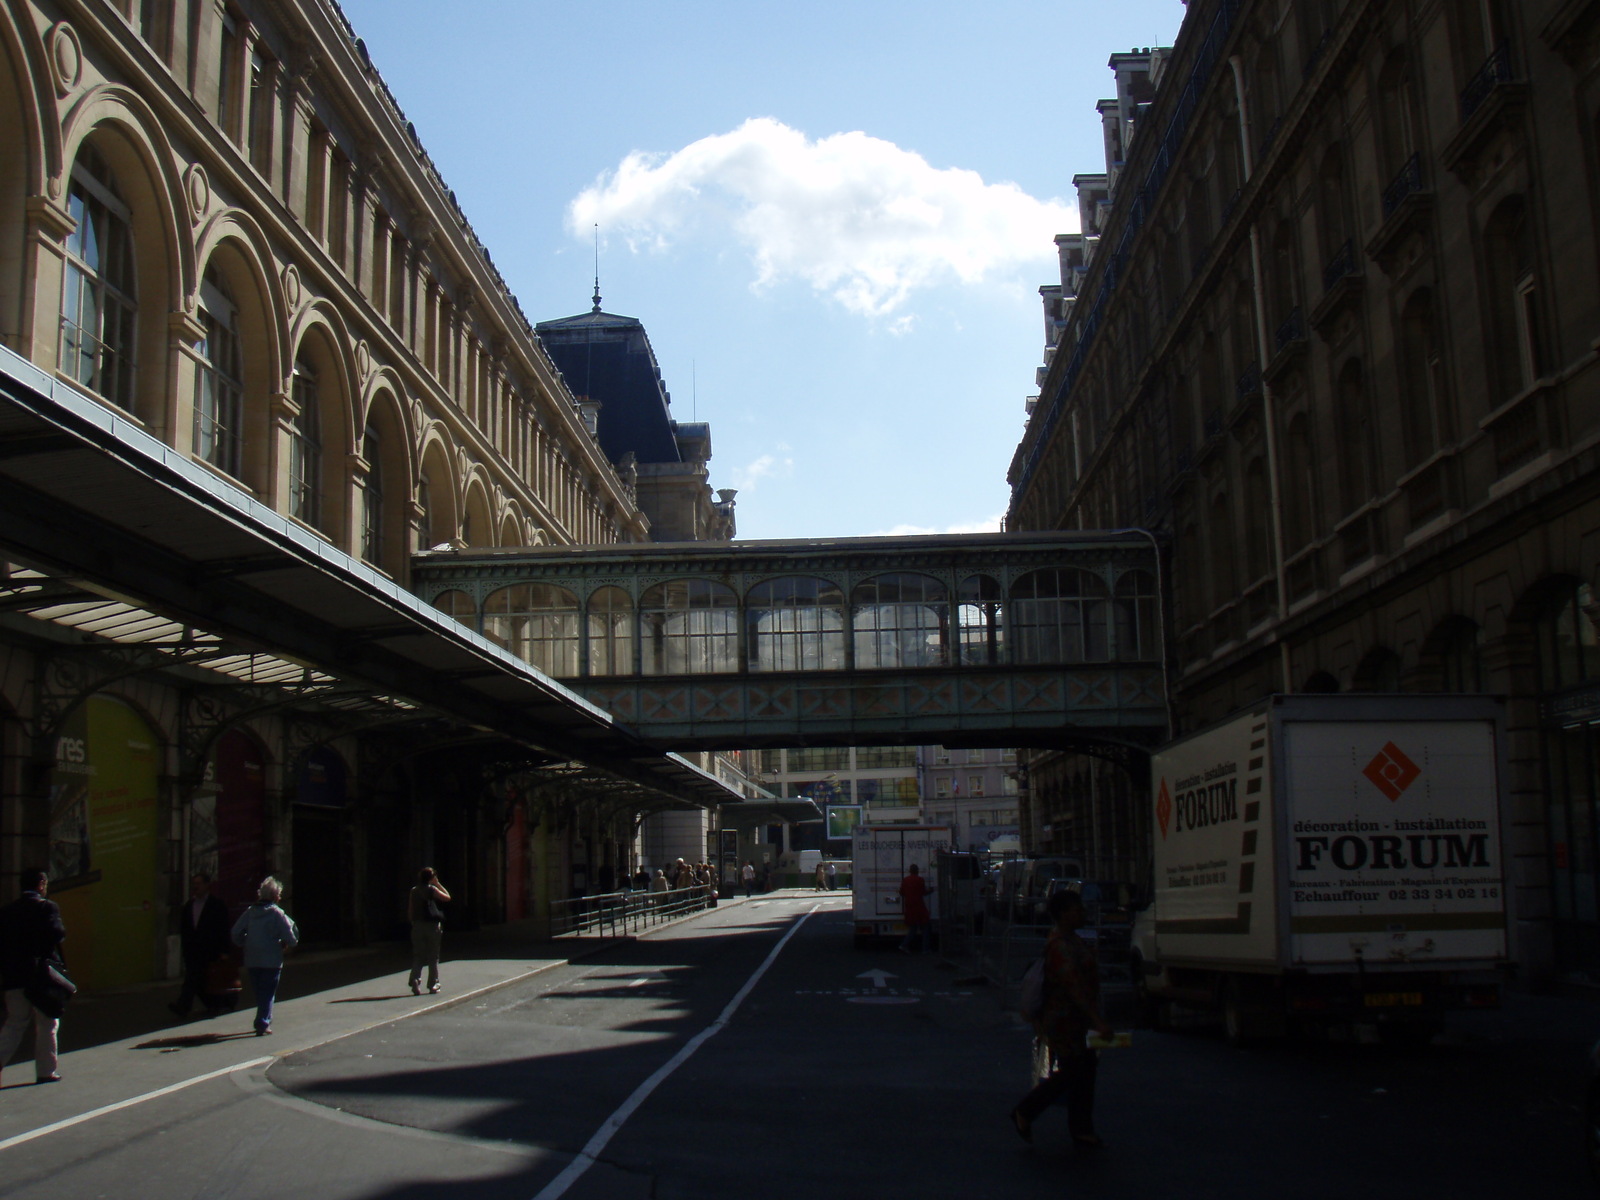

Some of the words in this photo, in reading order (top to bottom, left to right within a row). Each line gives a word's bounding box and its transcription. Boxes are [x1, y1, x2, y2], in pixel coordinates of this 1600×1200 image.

[1175, 778, 1238, 832] FORUM
[1293, 819, 1379, 832] décoration
[1394, 818, 1487, 831] installation
[1296, 834, 1490, 870] FORUM
[1289, 880, 1331, 888] Bureaux
[1339, 878, 1396, 887] Fabrication
[1401, 877, 1442, 888] Magasin
[1293, 889, 1380, 902] Echauffour
[1389, 890, 1406, 900] 02
[1412, 890, 1430, 900] 33
[1435, 889, 1452, 899] 34
[1457, 888, 1475, 899] 02
[1482, 887, 1498, 898] 16
